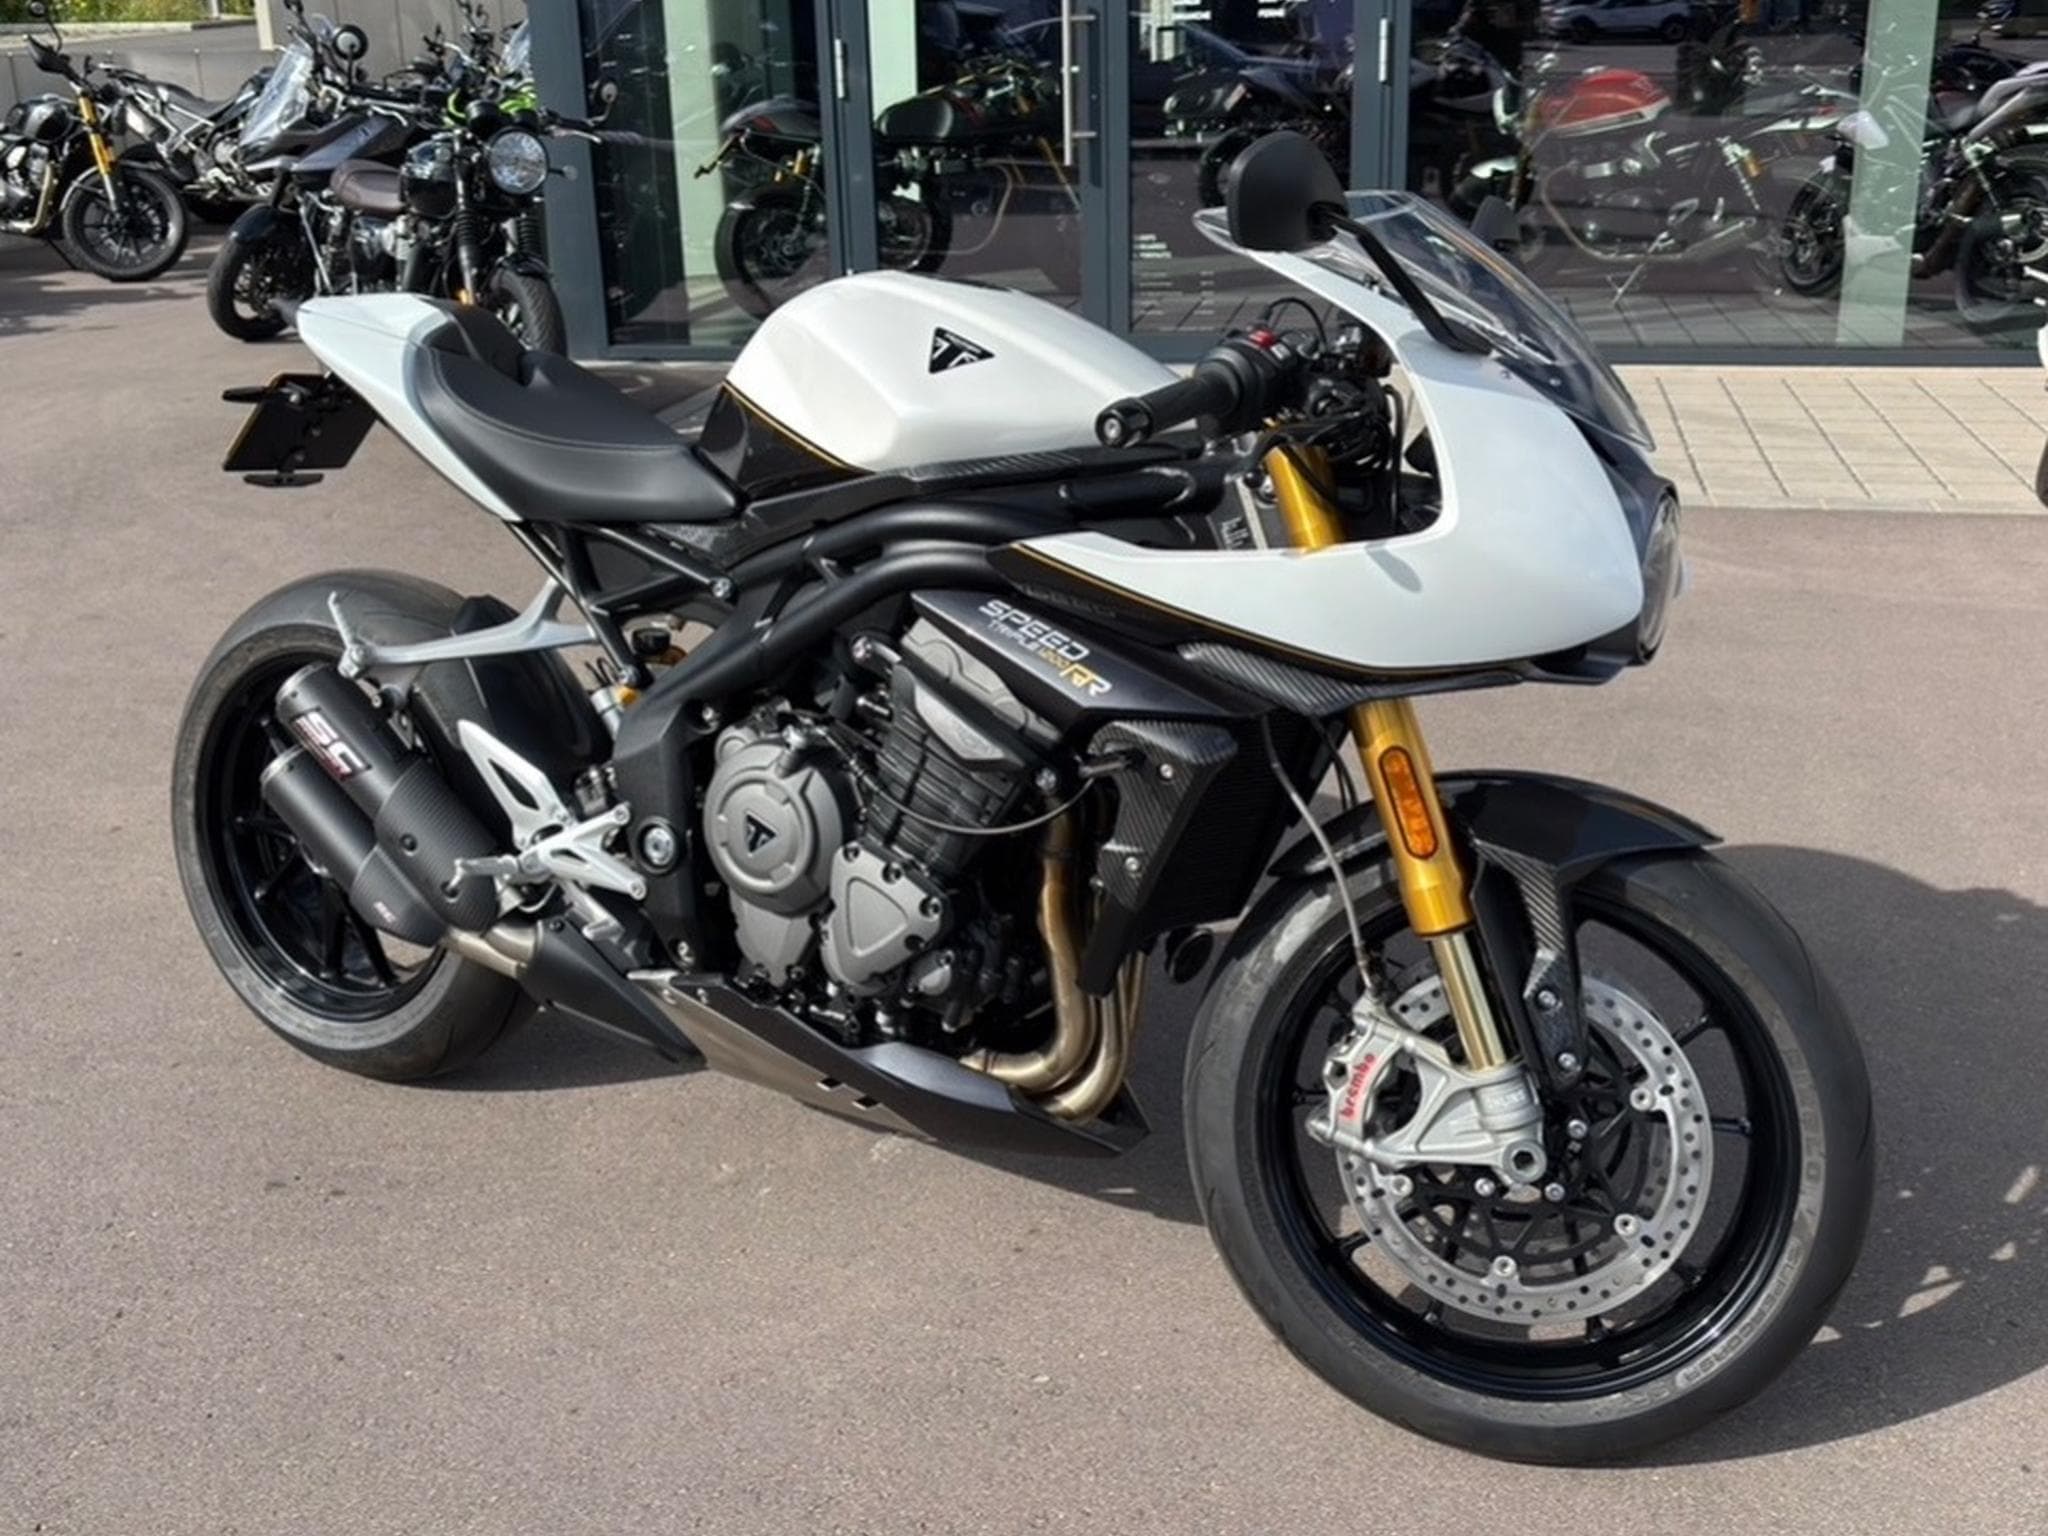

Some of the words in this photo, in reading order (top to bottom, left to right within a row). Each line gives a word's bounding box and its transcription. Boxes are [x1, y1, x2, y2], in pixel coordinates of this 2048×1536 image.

[979, 600, 1090, 661] SPEED
[988, 620, 1041, 651] TRIPLE
[1059, 663, 1112, 697] RR
[295, 711, 366, 774] SC
[1340, 1053, 1376, 1118] brembo
